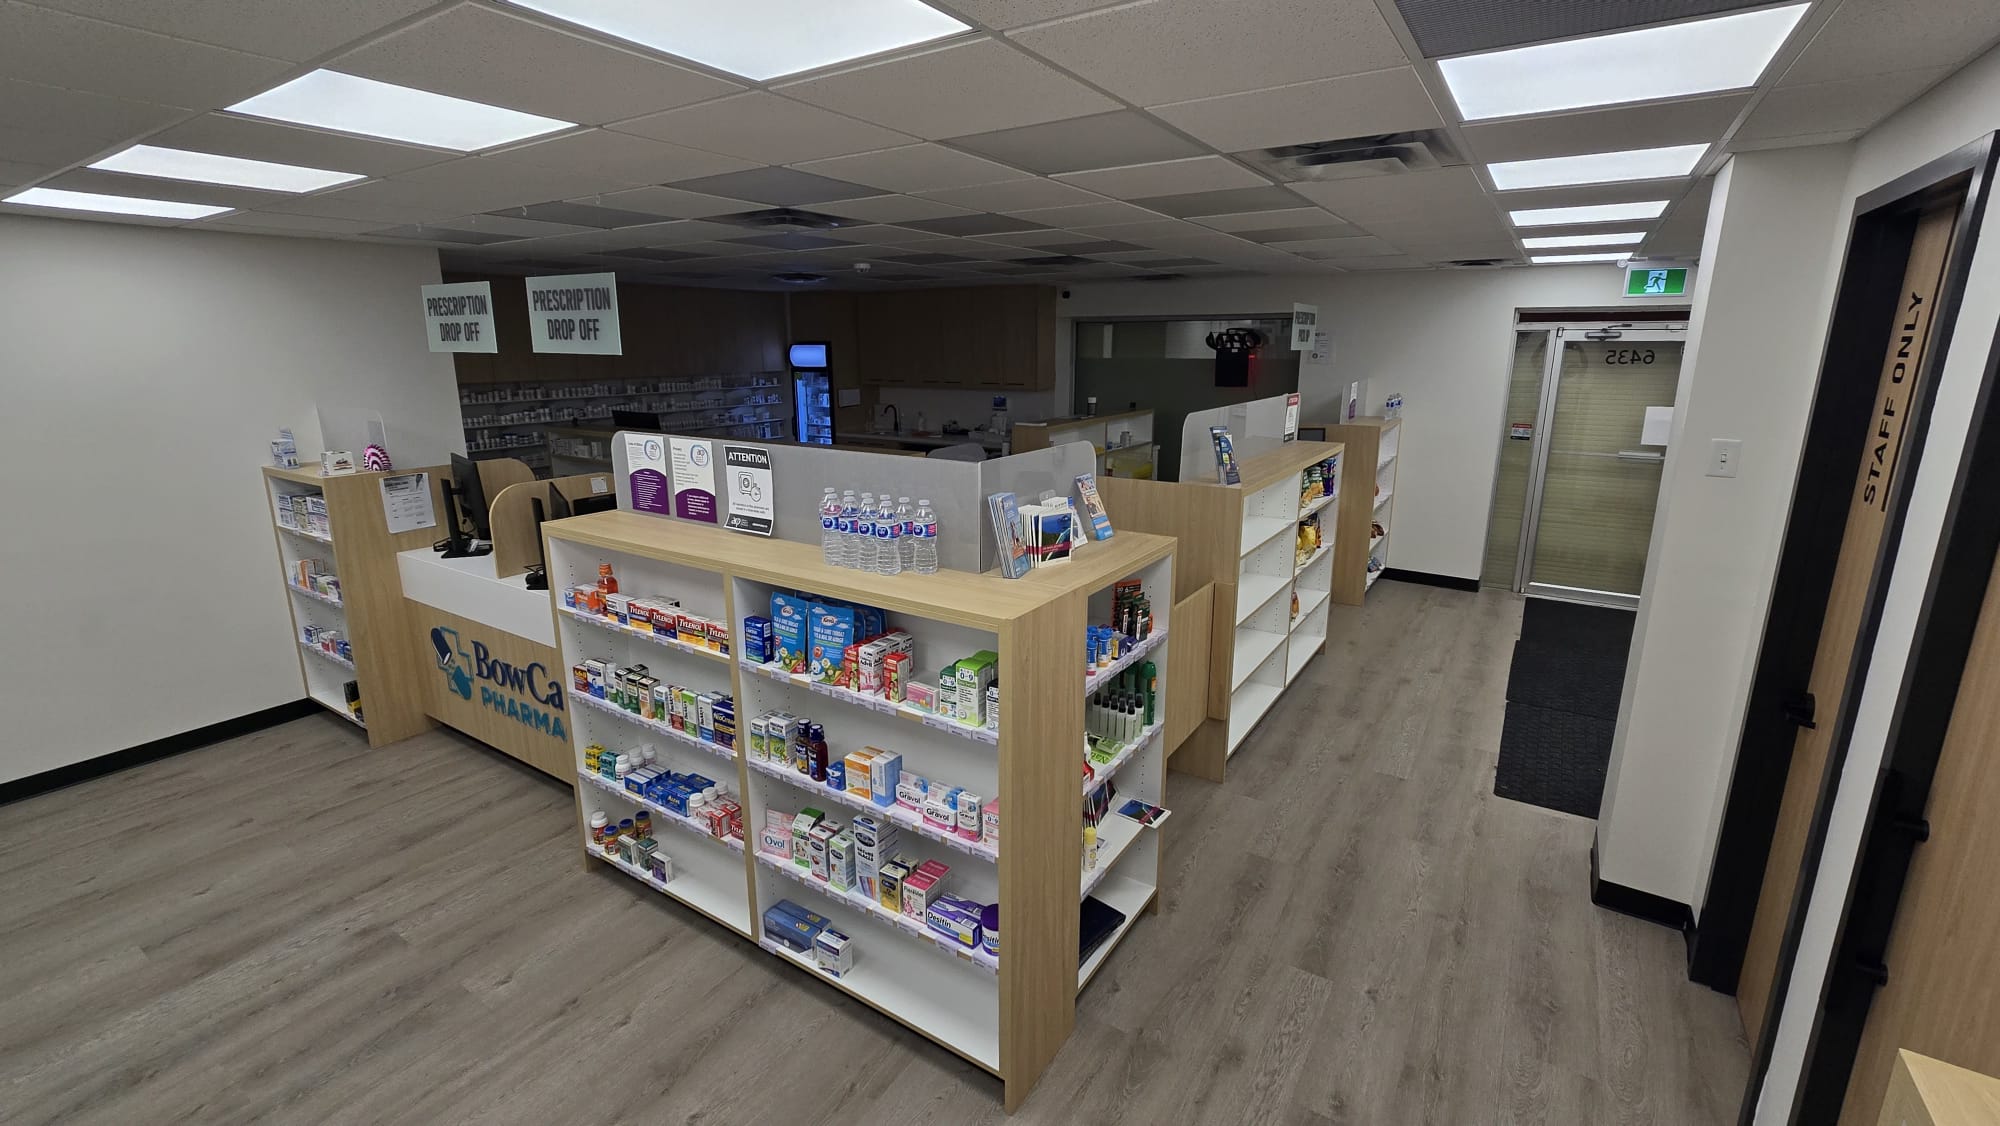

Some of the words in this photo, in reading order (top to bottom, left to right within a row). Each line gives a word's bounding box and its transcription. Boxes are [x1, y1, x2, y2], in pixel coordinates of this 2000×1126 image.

[427, 294, 488, 317] PRESCRIPTION
[533, 287, 611, 312] PRESCRIPTION
[439, 322, 462, 342] DROP
[464, 321, 480, 342] OFF
[547, 318, 575, 341] DROP
[579, 318, 600, 341] OFF
[1863, 396, 1896, 505] STAFF
[1892, 291, 1923, 384] ONLY
[728, 452, 767, 465] ATTENTION
[630, 606, 650, 617] TYLENOL
[653, 612, 674, 625] TYLENOL
[679, 619, 702, 632] TYLENOL
[709, 627, 729, 640] TYLENO
[479, 686, 567, 742] PHARMA
[899, 791, 921, 804] Gravol
[926, 807, 950, 821] Gravol
[765, 836, 785, 849] Ovol
[927, 910, 951, 928] Desitin
